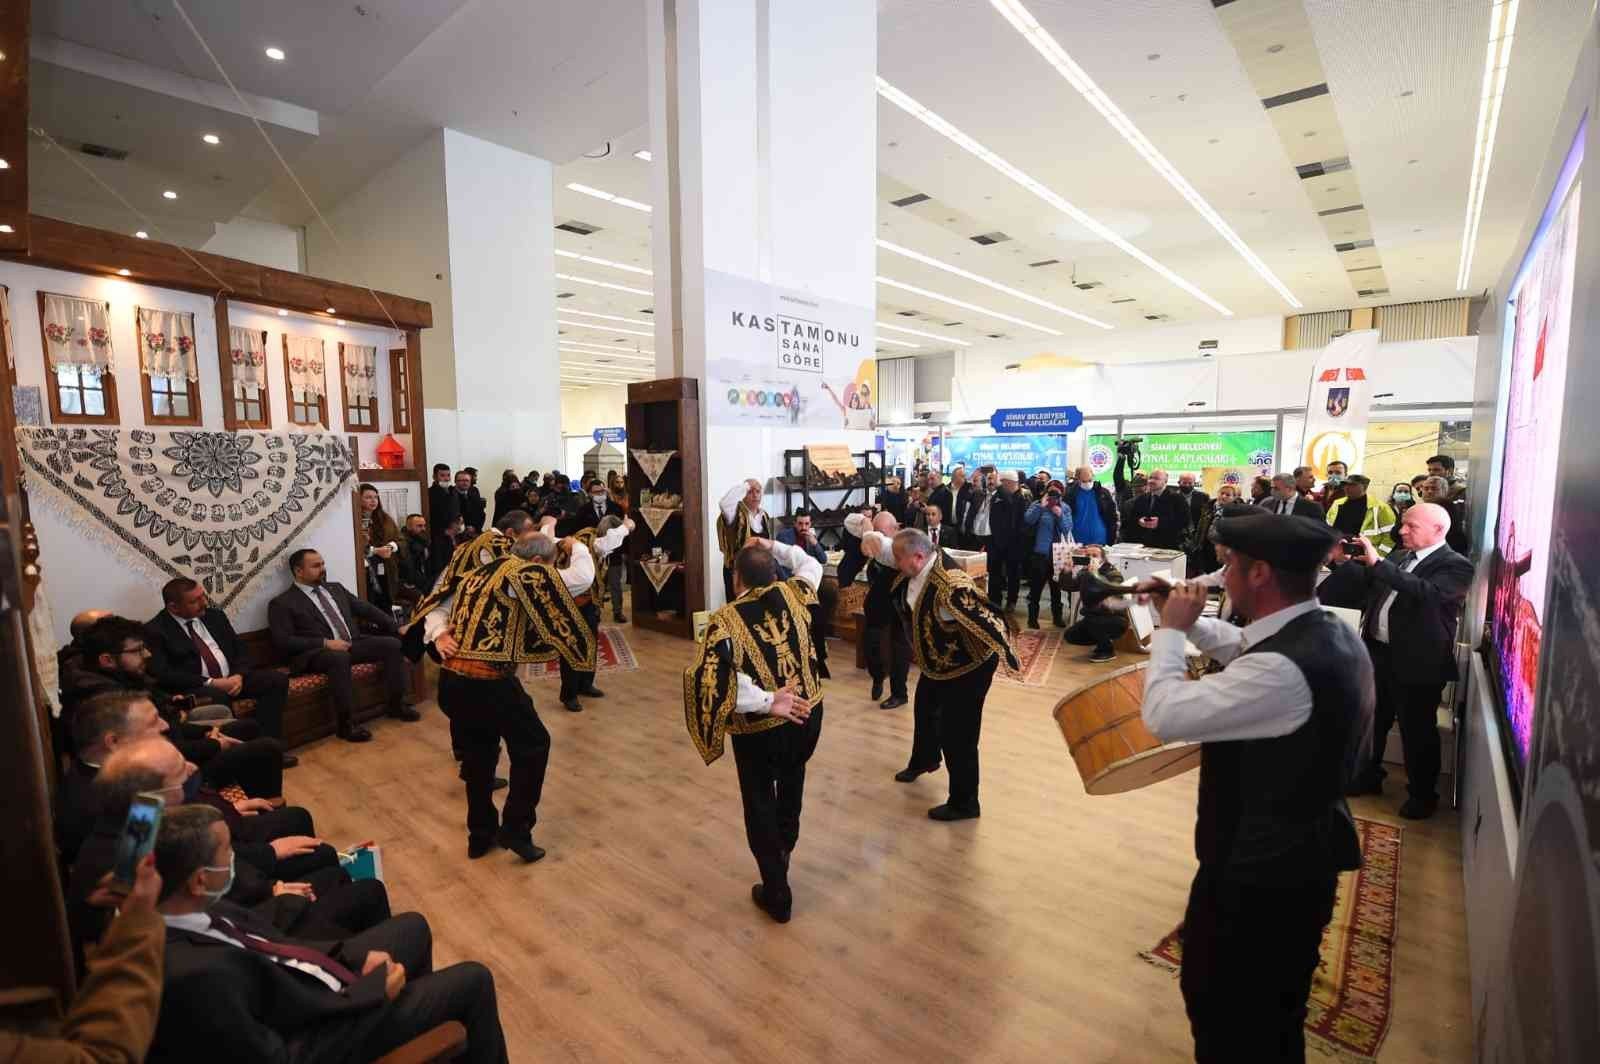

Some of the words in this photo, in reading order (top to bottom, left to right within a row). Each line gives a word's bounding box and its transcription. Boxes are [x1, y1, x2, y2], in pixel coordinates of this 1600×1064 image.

[732, 311, 859, 347] KASTAMONU
[782, 338, 820, 353] SANA
[782, 352, 820, 368] GÖRE
